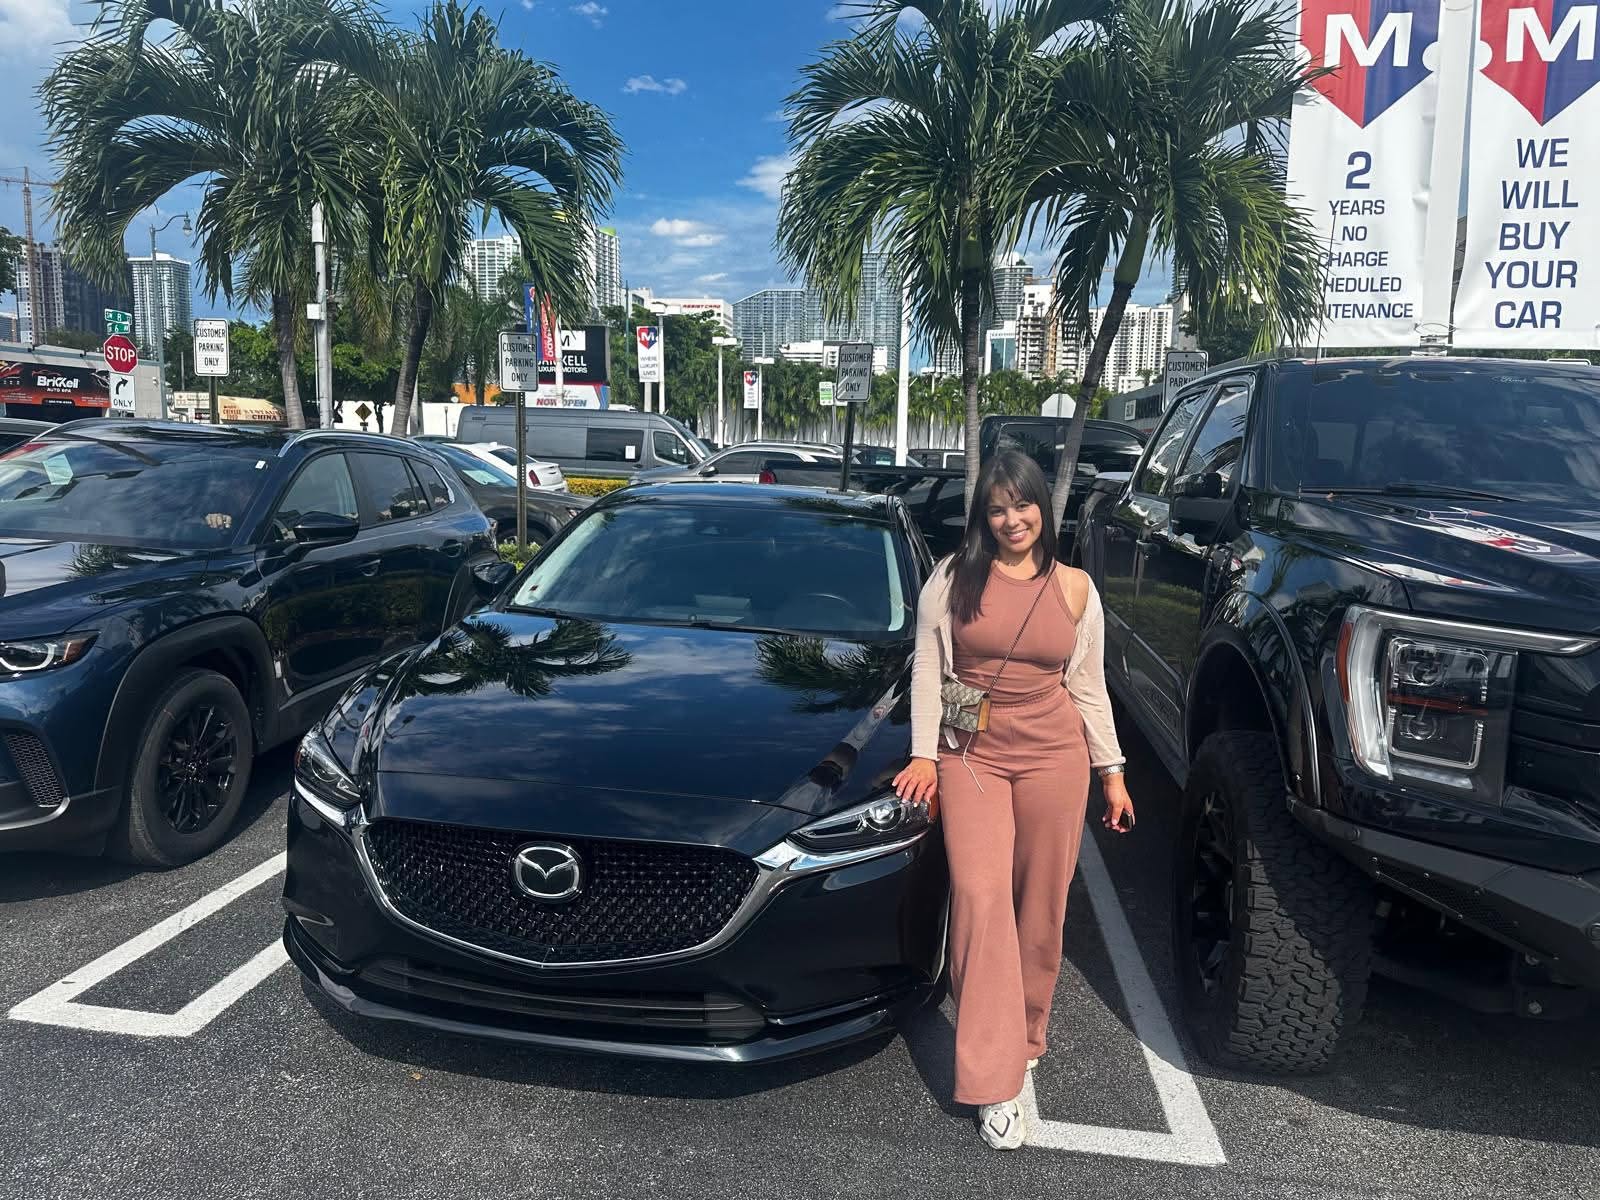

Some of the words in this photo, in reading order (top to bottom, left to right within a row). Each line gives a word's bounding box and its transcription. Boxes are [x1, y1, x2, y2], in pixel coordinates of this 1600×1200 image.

[1324, 12, 1413, 68] M
[1506, 5, 1598, 63] M
[1517, 138, 1569, 168] WE
[1345, 151, 1371, 189] 2
[1502, 180, 1578, 209] WILL
[1329, 200, 1385, 215] YEARS
[1342, 226, 1367, 241] NO
[1500, 222, 1570, 250] BUY
[1485, 260, 1577, 289] YOUR
[1321, 277, 1402, 293] HEDULED
[1495, 300, 1562, 329] CAR
[196, 328, 226, 338] CUSTOMER
[106, 345, 135, 363] STOP
[198, 342, 225, 353] PARKING
[502, 342, 536, 353] CUSTOMER
[204, 357, 219, 367] ONLY
[505, 357, 534, 368] PARKING
[840, 353, 871, 363] CUSTOMER
[841, 367, 868, 378] PARKING
[1167, 361, 1205, 372] CUSTOMER
[511, 372, 528, 383] ONLY
[845, 382, 860, 393] ONLY
[113, 398, 133, 408] ONLY
